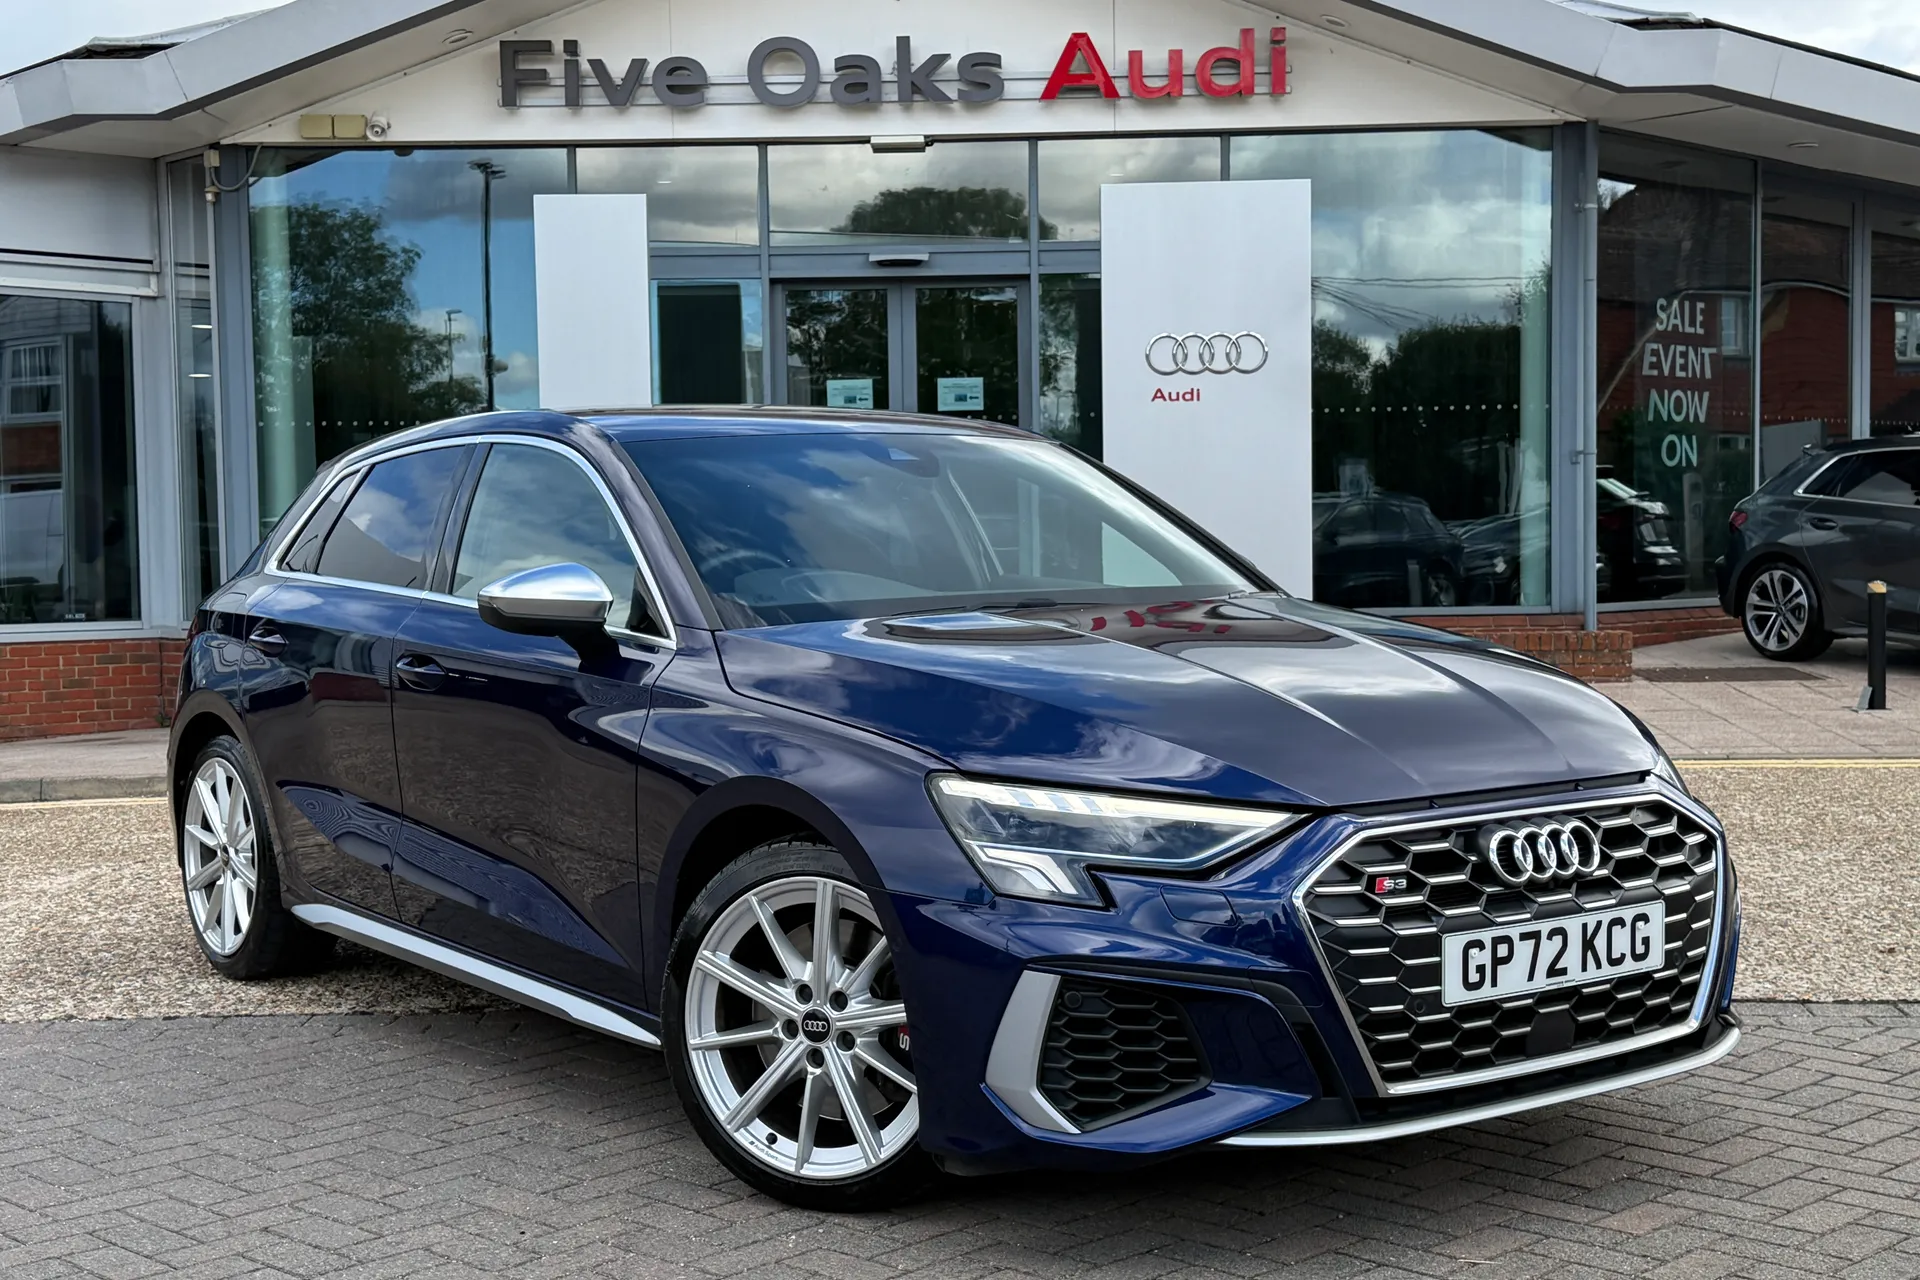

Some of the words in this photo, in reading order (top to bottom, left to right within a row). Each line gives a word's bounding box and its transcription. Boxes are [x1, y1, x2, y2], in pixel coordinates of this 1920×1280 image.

[499, 39, 709, 109] Five
[747, 35, 1005, 107] Oaks
[1039, 27, 1287, 101] Audi
[1656, 298, 1705, 334] SALE
[1642, 343, 1717, 379] EVENT
[1150, 387, 1201, 402] Audi
[1648, 389, 1709, 423] NOW
[1661, 434, 1698, 467] ON
[1382, 878, 1408, 890] S3
[1462, 926, 1569, 991] GP72
[1581, 912, 1651, 973] KCG
